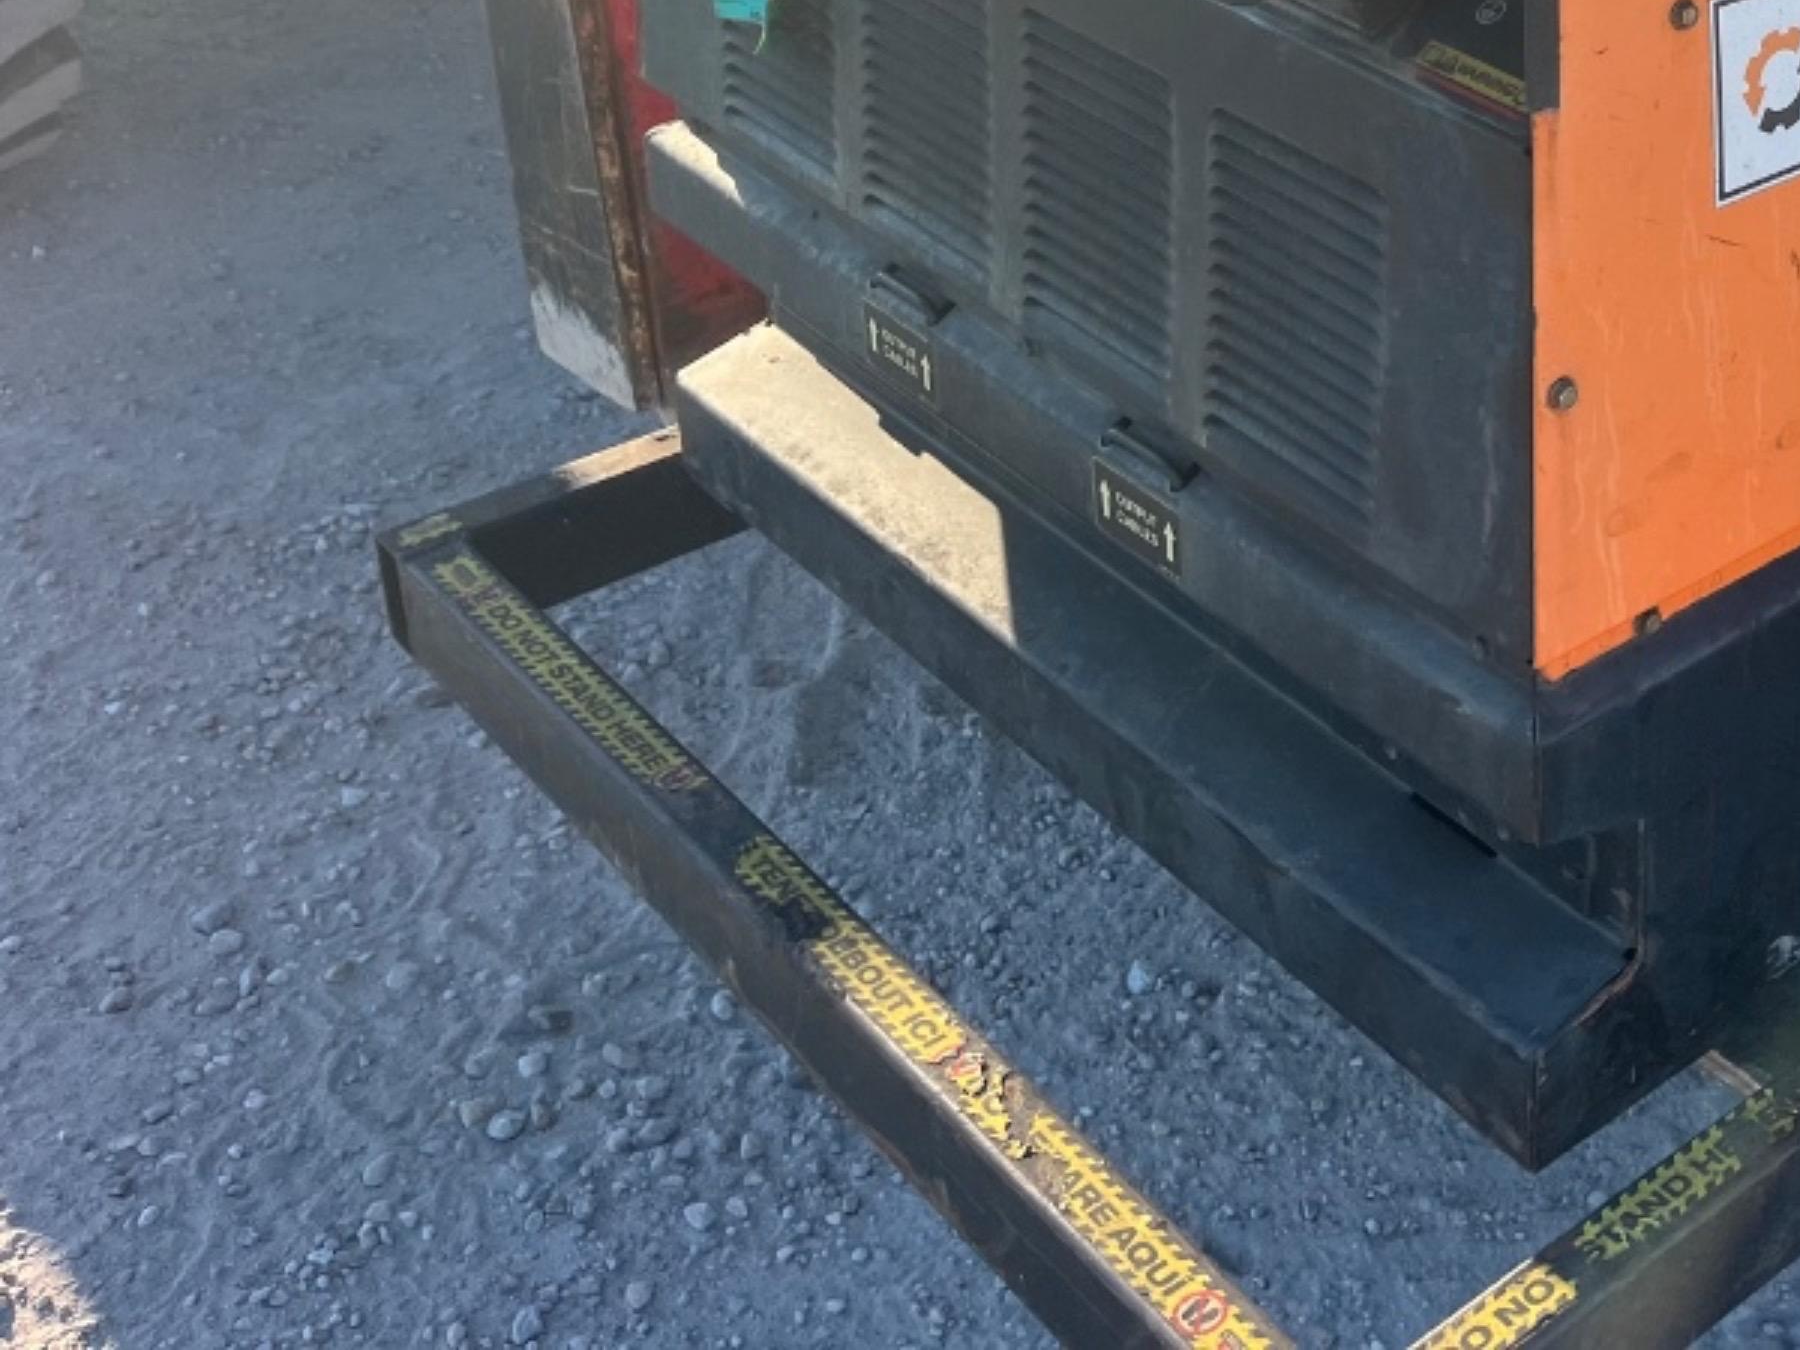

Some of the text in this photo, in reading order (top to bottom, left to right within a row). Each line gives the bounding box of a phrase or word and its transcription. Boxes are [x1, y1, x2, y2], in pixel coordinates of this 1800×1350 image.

[488, 605, 522, 631] DO
[550, 663, 615, 721] STAND
[605, 719, 671, 772] HERE
[900, 1013, 947, 1049] ICI
[1060, 1166, 1122, 1227] ARE
[1493, 1278, 1556, 1328] NO
